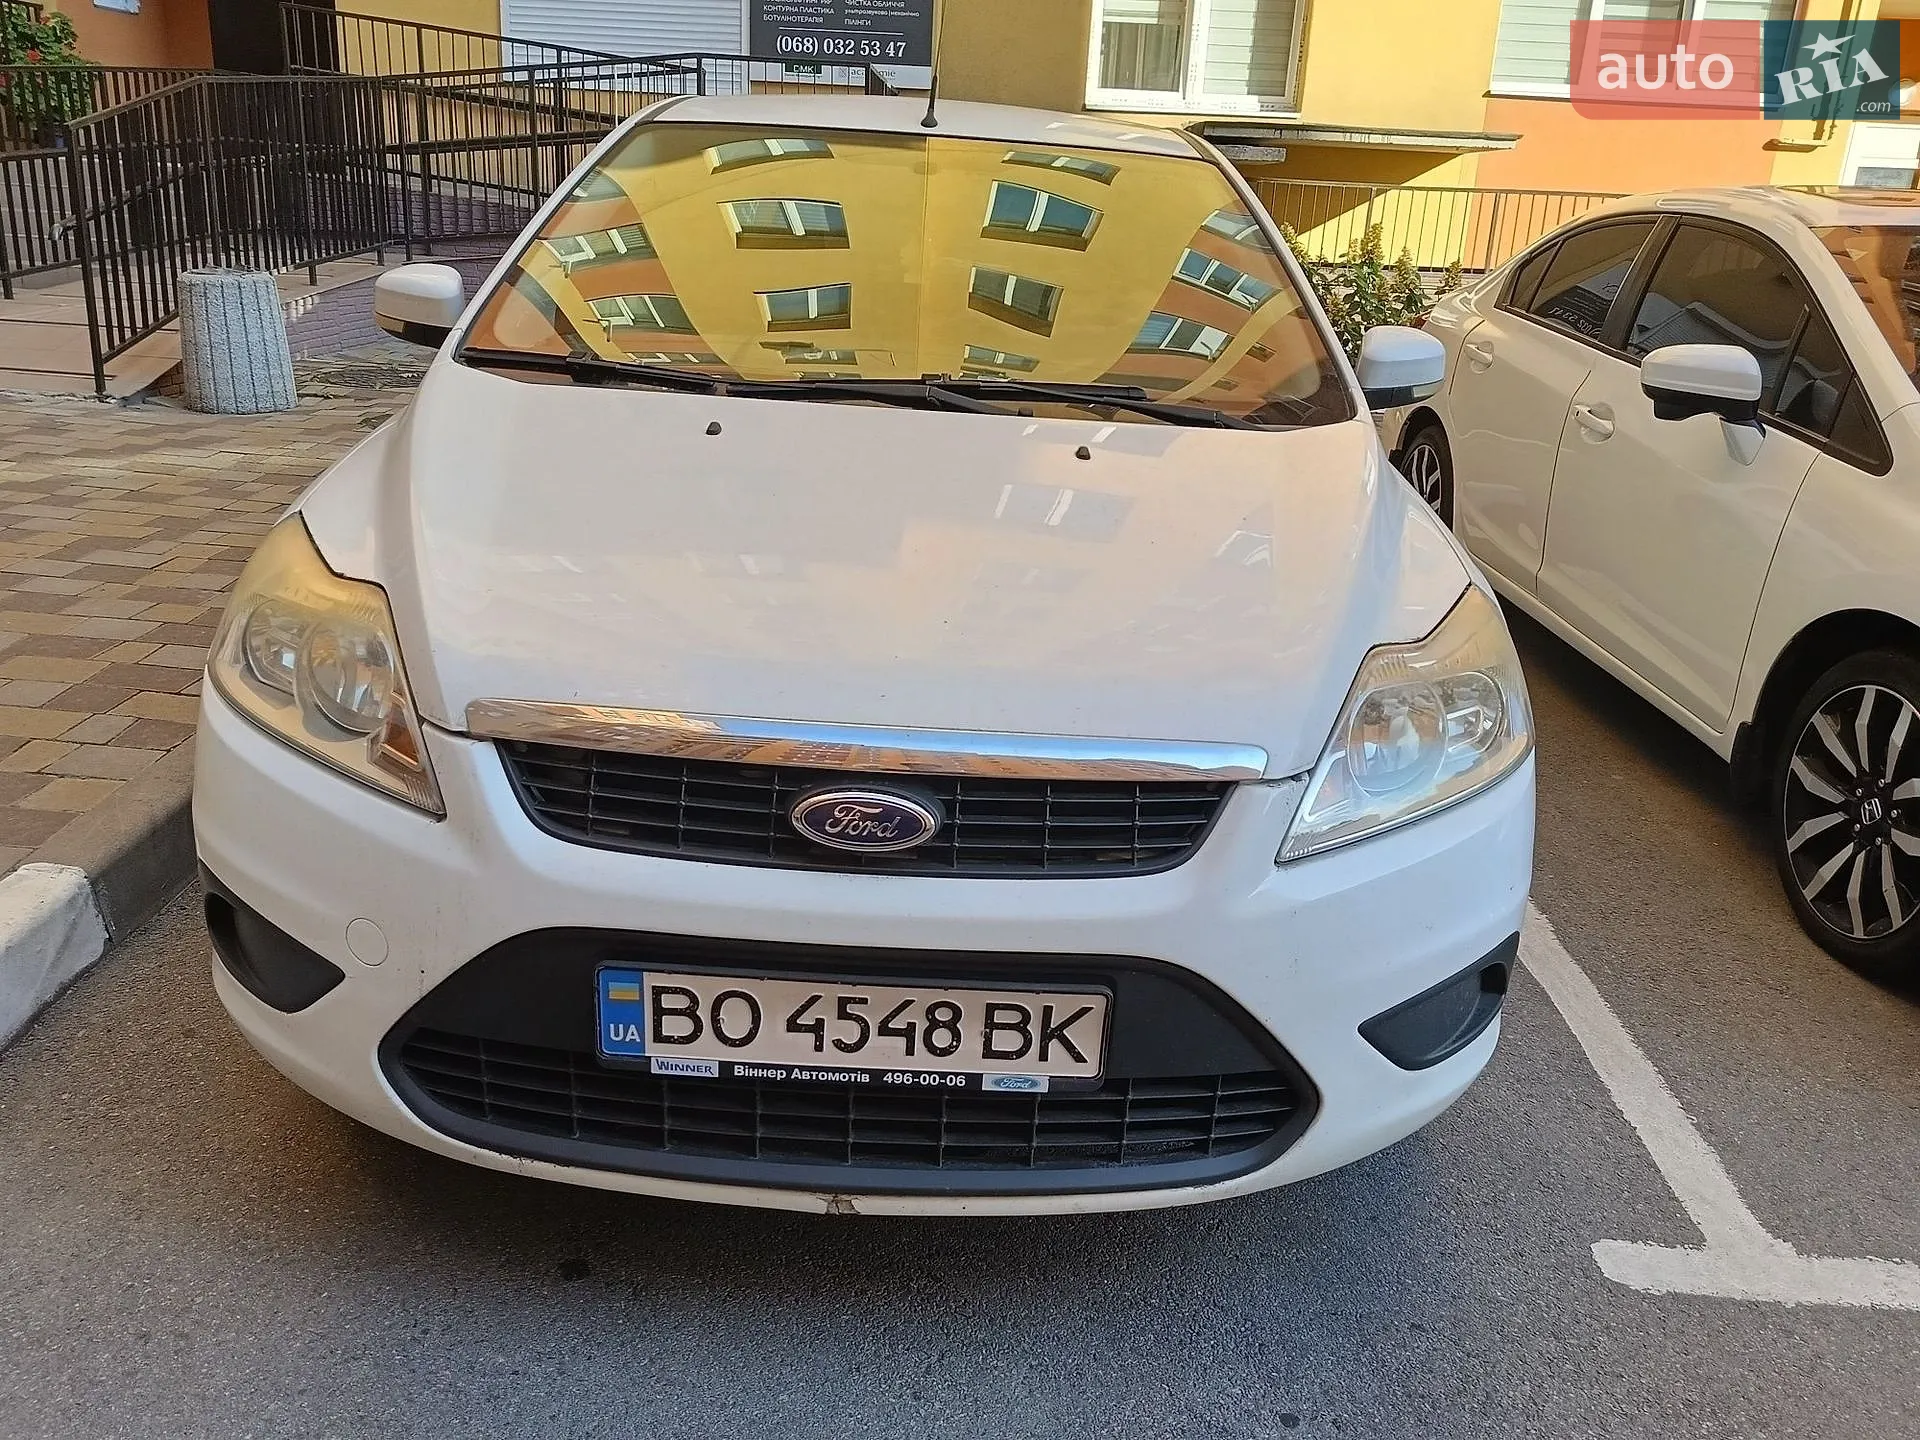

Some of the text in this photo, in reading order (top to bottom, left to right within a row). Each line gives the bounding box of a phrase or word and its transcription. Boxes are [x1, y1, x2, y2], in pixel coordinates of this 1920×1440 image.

[763, 5, 835, 14] КОНТУРНА ПЛАСТИКА
[872, 0, 905, 8] ОБЛИЧЧЯ
[776, 34, 907, 58] (068) 032 53 47
[825, 804, 902, 838] Ford
[608, 1023, 641, 1043] UA
[650, 984, 1095, 1064] BO 4548 BK
[655, 1058, 714, 1075] WINNER
[734, 1065, 966, 1087] Віннер Автомотів 496-00-06
[1000, 1078, 1032, 1089] Ford
